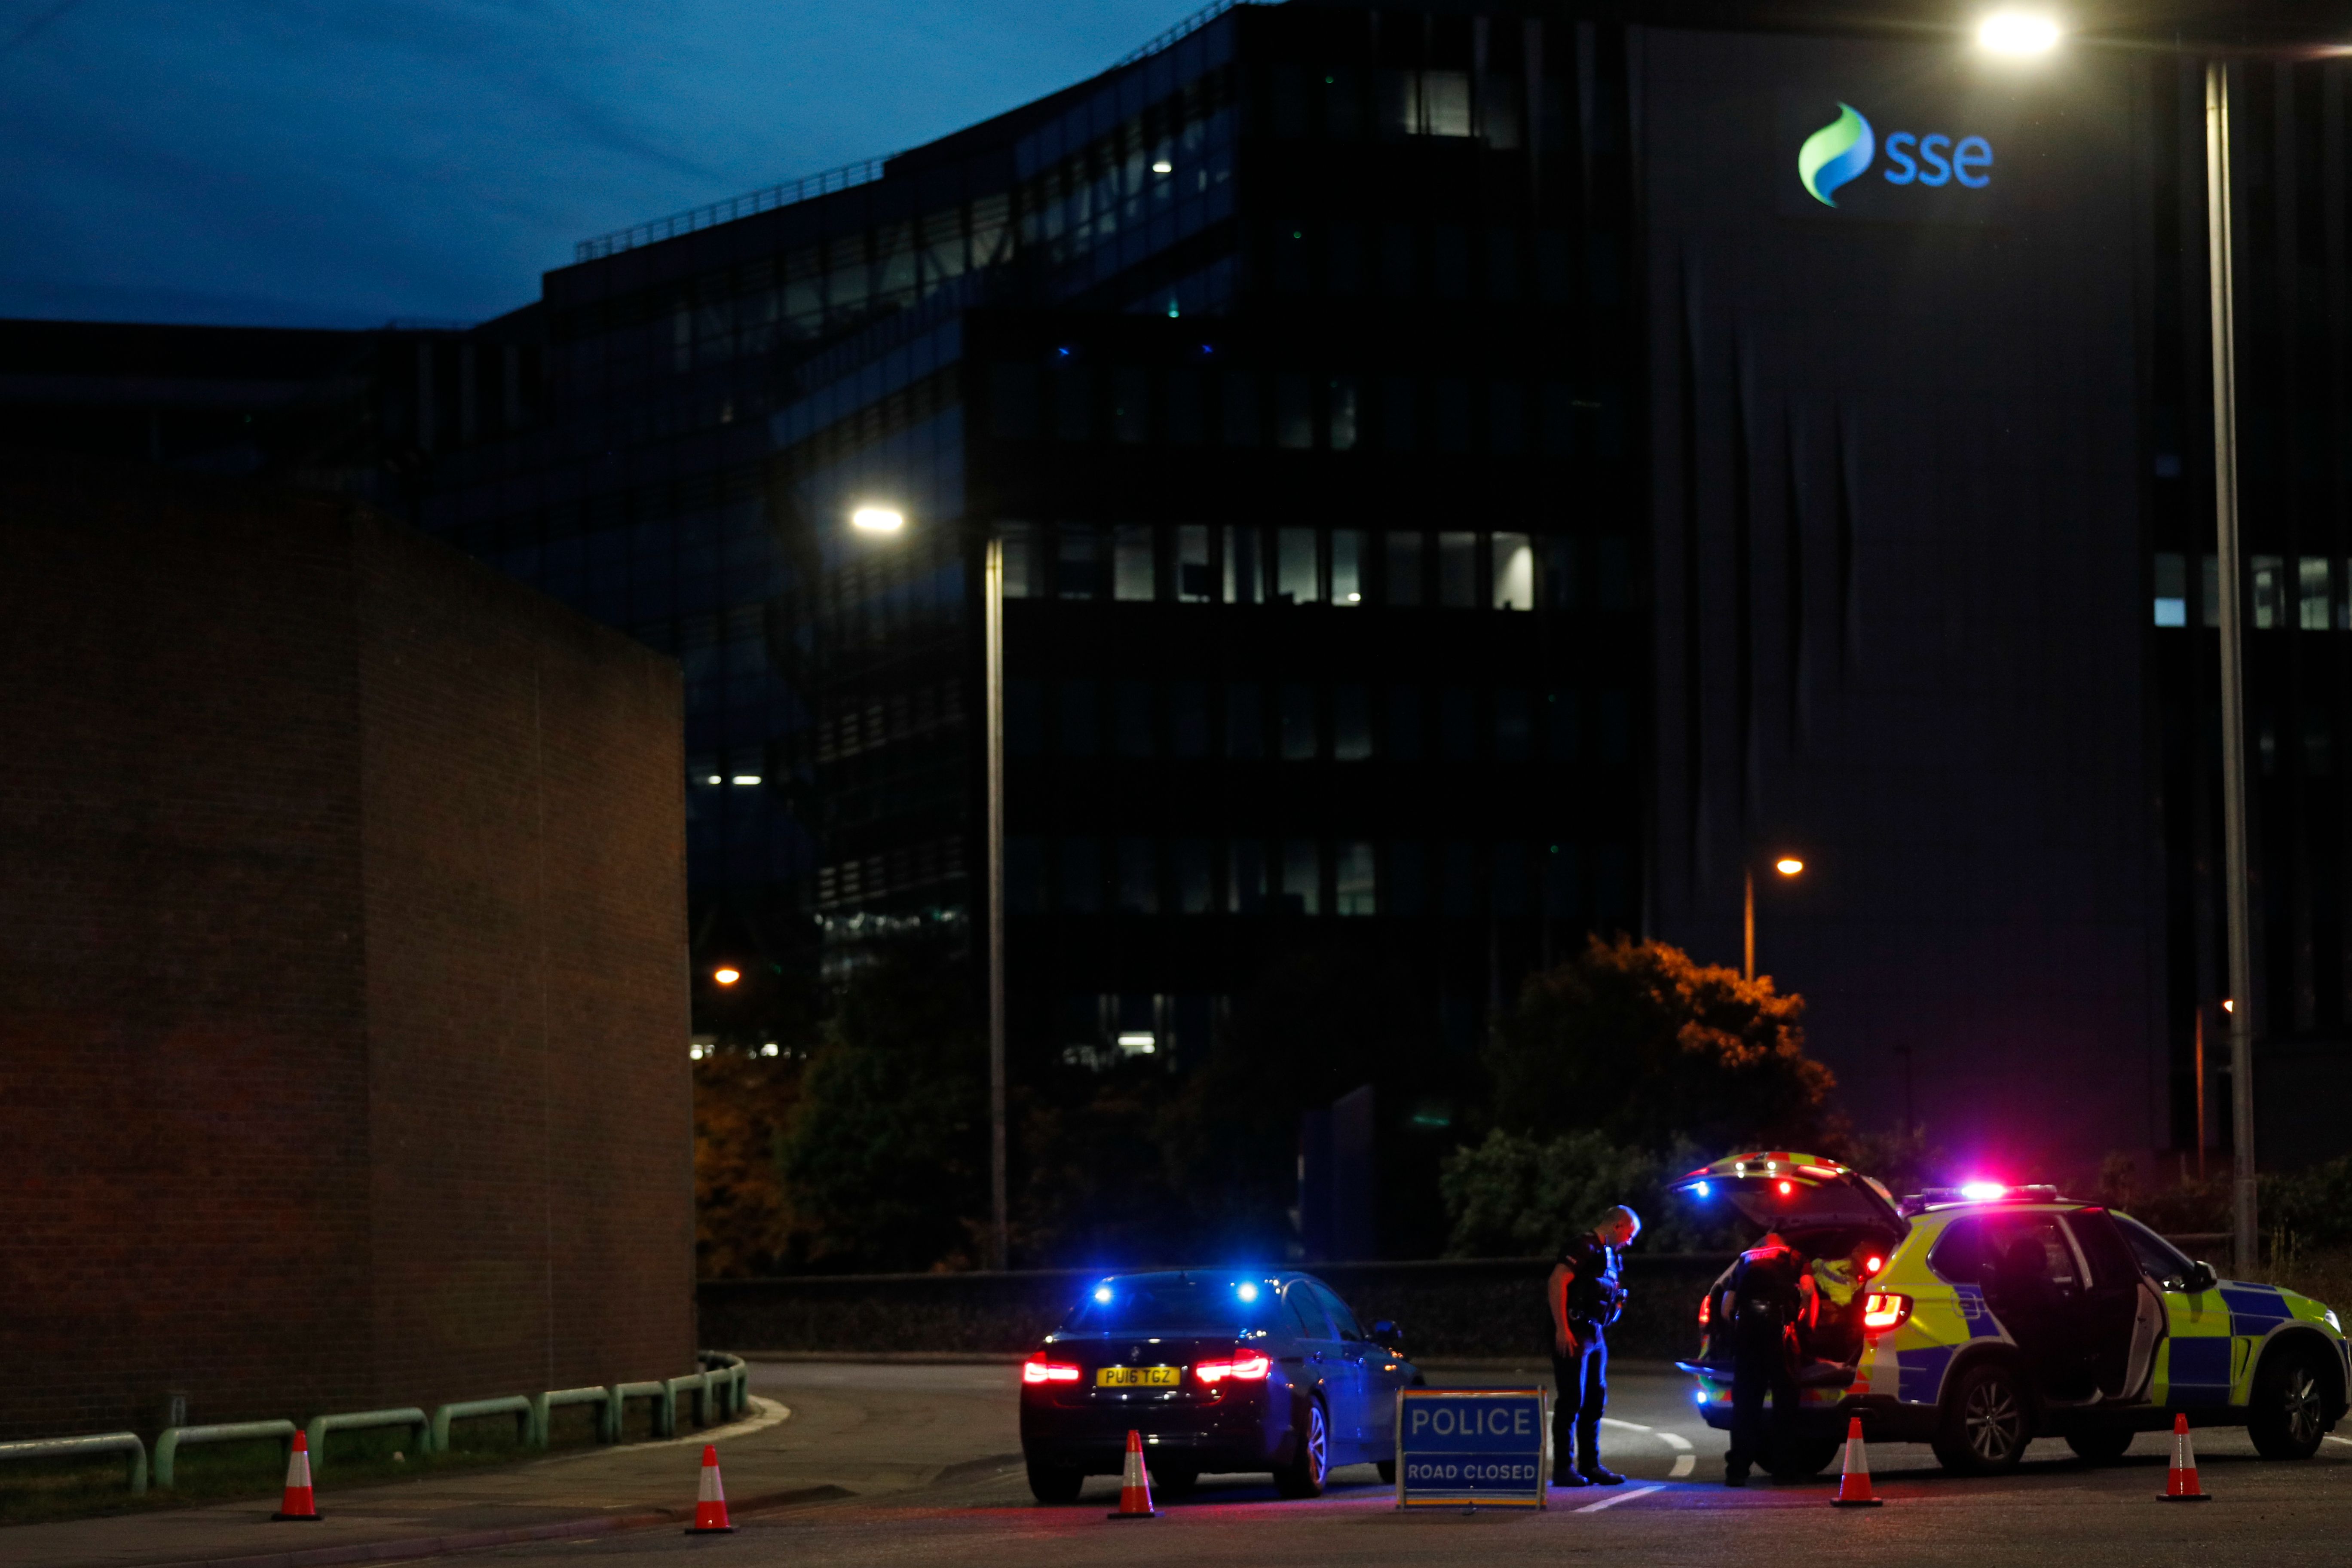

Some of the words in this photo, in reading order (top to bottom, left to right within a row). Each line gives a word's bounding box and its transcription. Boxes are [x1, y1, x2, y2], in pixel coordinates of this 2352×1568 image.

[1884, 132, 1993, 188] sse
[1106, 1370, 1138, 1383] PU16
[1142, 1370, 1170, 1382] TGZ
[1412, 1408, 1531, 1435] POLICE
[1409, 1464, 1458, 1479] ROAD
[1464, 1464, 1535, 1479] CLOSED
